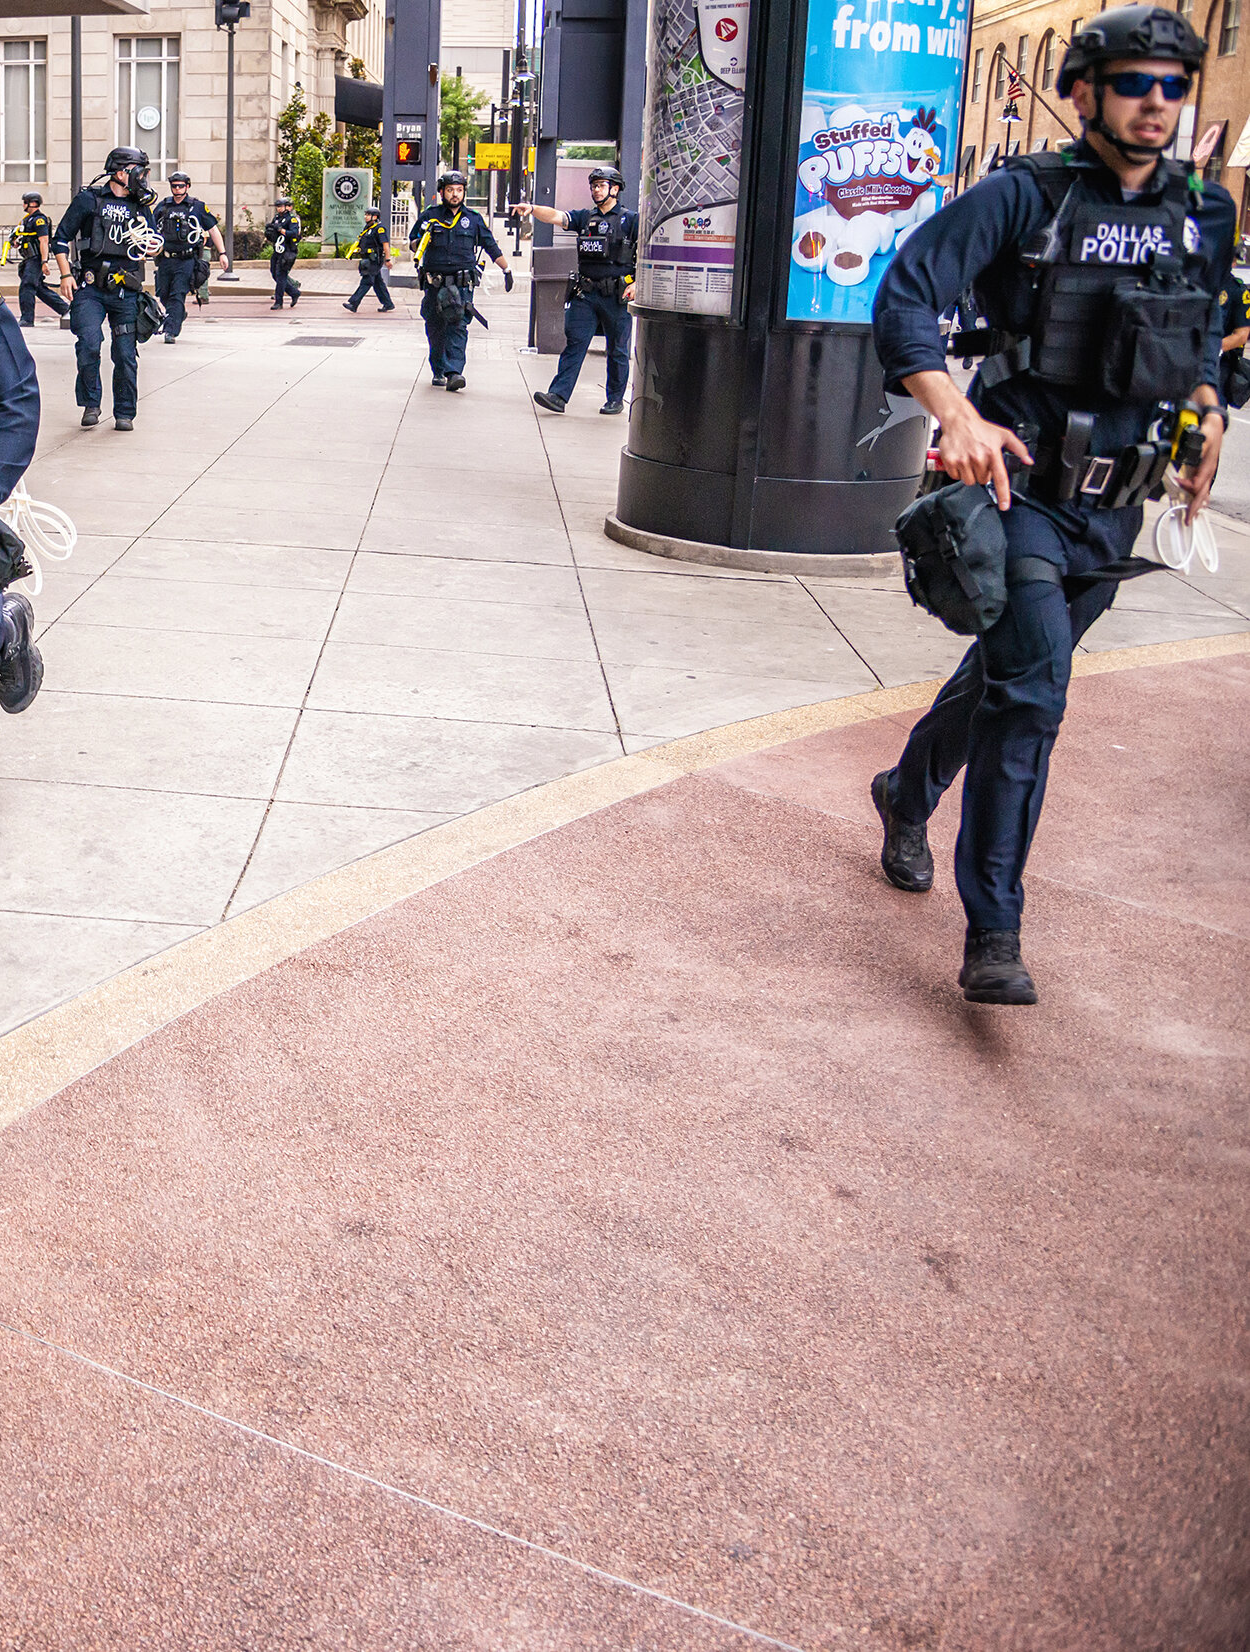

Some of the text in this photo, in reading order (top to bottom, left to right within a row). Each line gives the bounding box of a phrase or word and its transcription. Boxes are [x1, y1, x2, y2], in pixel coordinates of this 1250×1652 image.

[833, 4, 921, 53] from
[396, 123, 422, 133] Bryan
[814, 122, 892, 150] Stuffed
[798, 140, 905, 194] PUFFS
[837, 183, 912, 199] Classic Milk Chocolate
[1096, 223, 1164, 243] DALLAS
